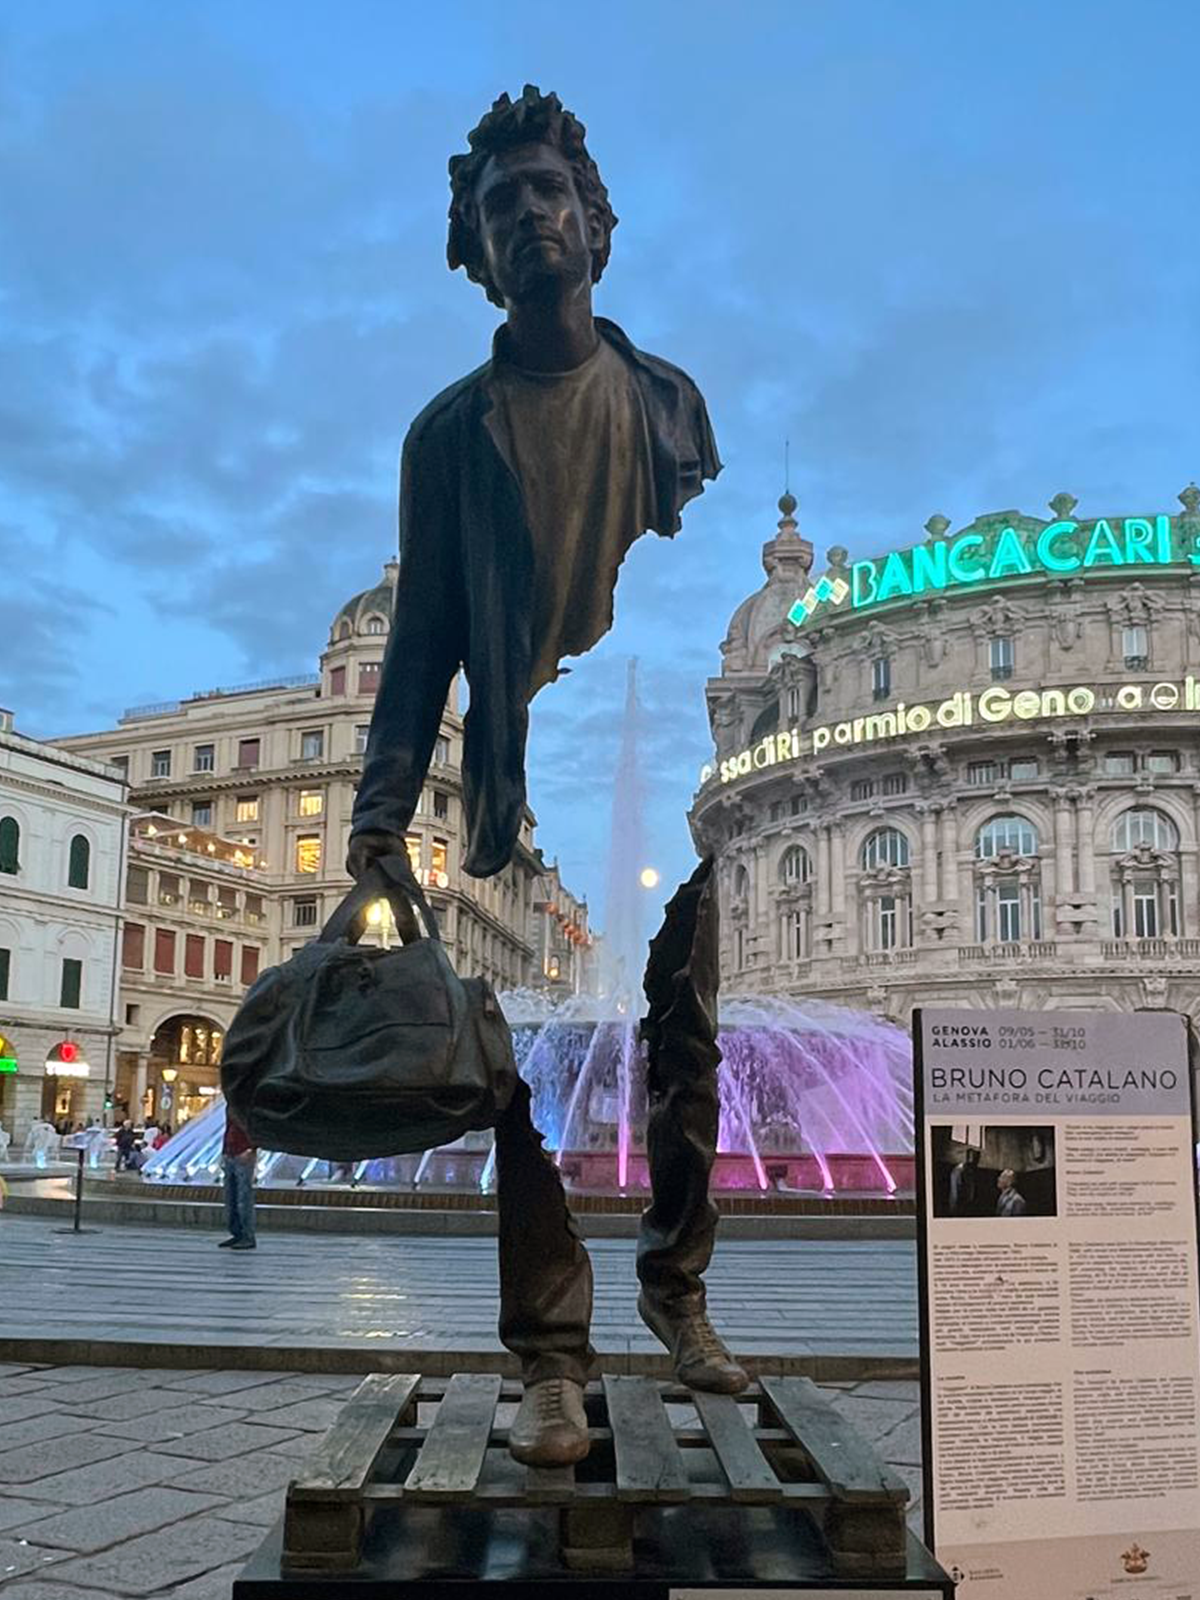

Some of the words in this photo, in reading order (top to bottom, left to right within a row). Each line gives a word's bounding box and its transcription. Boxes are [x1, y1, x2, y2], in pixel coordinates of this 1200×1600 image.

[936, 692, 973, 728] di
[931, 1026, 989, 1036] GENOVA
[998, 1026, 1035, 1037] 09/05
[931, 1038, 991, 1048] ALASSIO
[998, 1038, 1036, 1049] 01/06
[931, 1068, 1027, 1089] BRUNO
[1037, 1069, 1177, 1089] CATALANO
[933, 1092, 949, 1103] LA
[956, 1092, 1029, 1104] METAFORA
[1035, 1092, 1060, 1104] DEL
[1065, 1092, 1120, 1104] VIAGGIO
